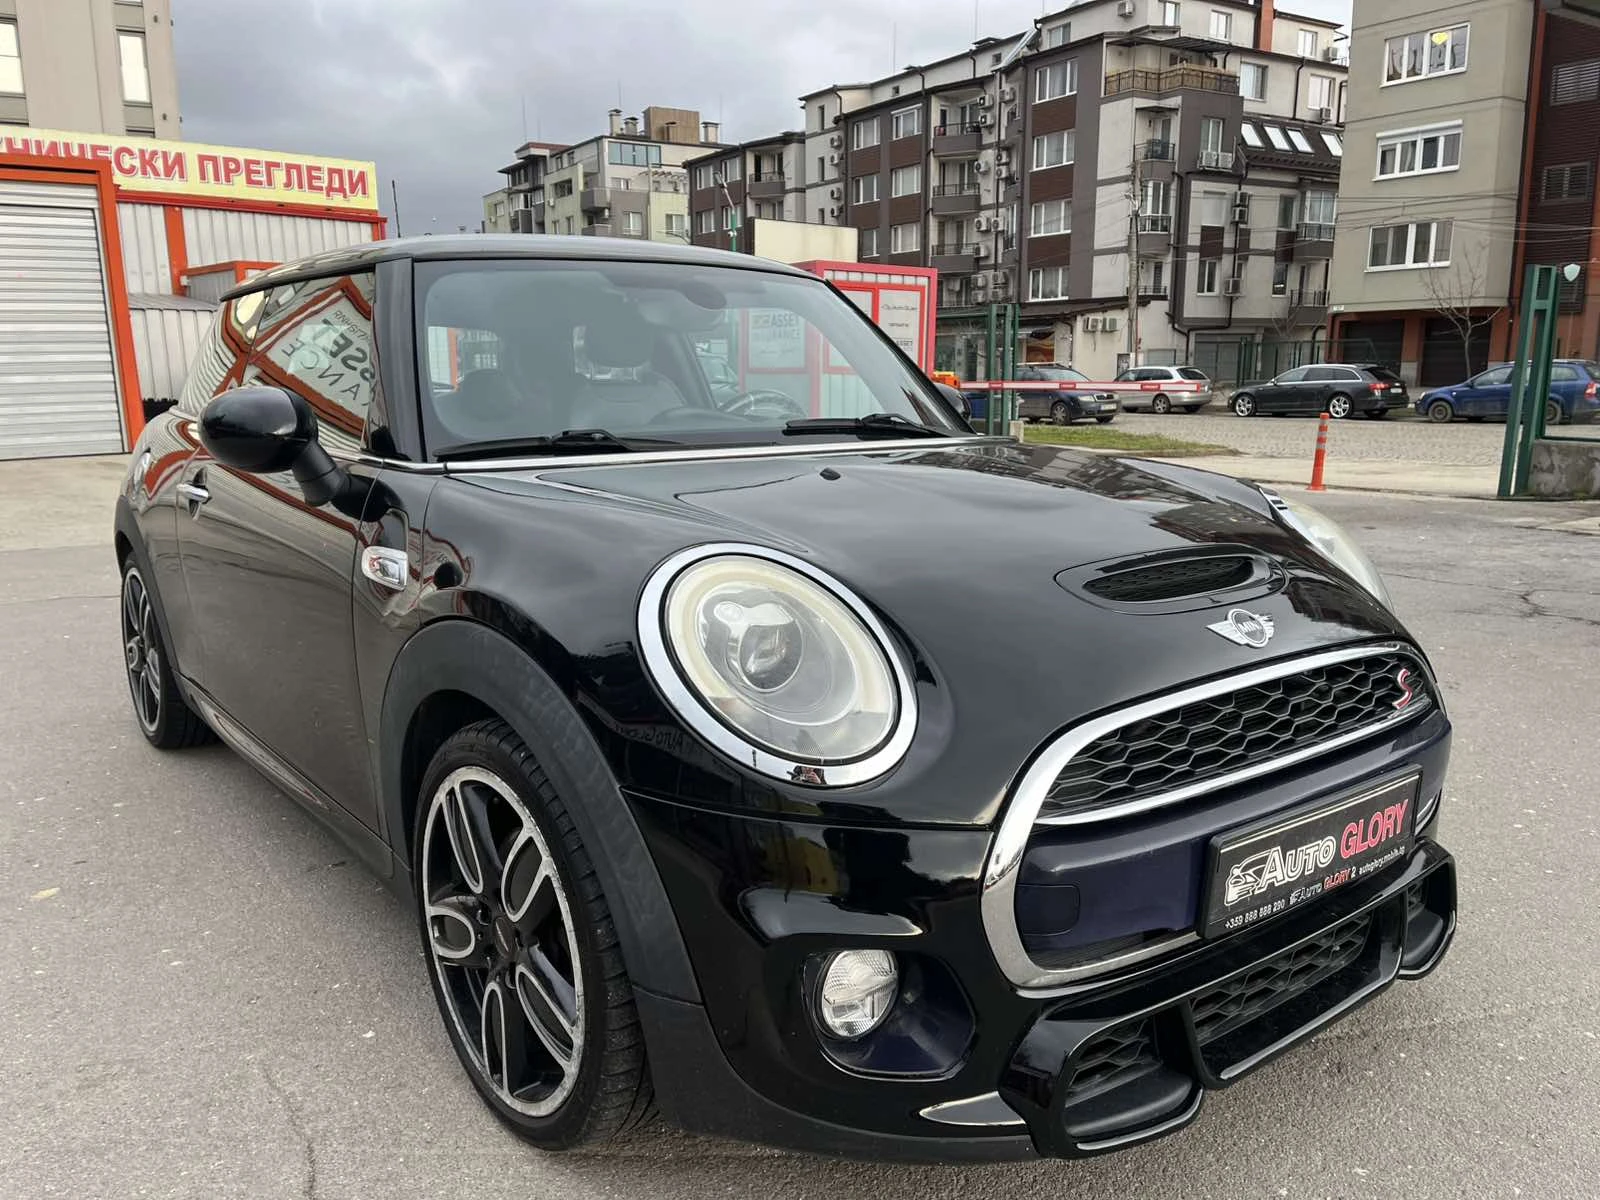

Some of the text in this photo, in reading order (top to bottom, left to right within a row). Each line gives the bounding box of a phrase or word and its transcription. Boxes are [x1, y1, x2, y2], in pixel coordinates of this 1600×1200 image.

[0, 136, 369, 199] НИЧЕСКИ ПРЕГЛЕДИ
[1391, 668, 1413, 710] S
[1255, 799, 1409, 894] AUTO GLORY
[1224, 915, 1244, 929] +359
[1323, 868, 1351, 890] GLORY
[1351, 866, 1357, 879] 2
